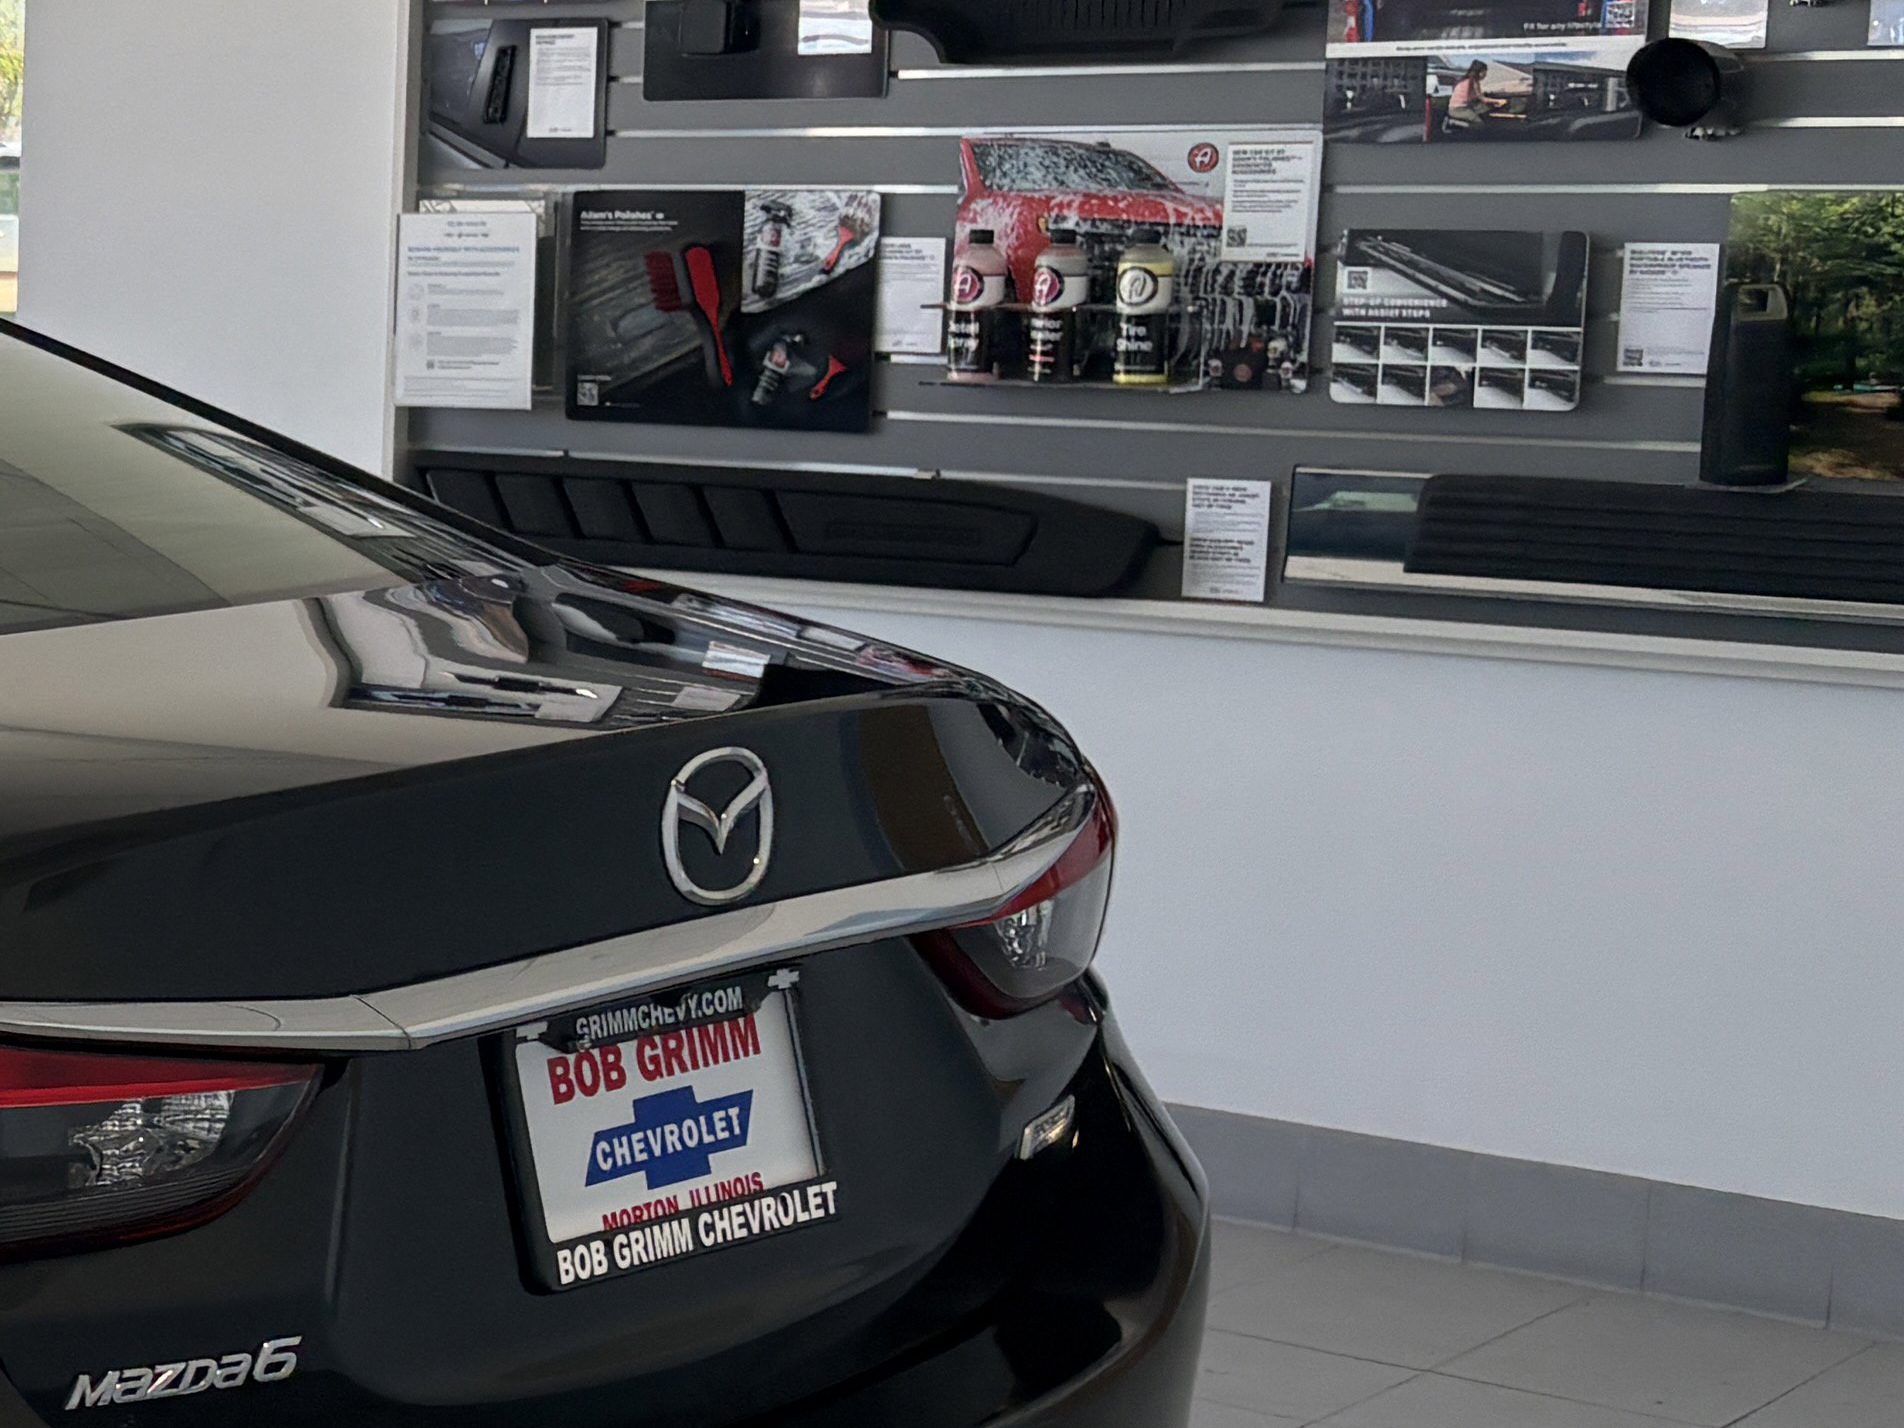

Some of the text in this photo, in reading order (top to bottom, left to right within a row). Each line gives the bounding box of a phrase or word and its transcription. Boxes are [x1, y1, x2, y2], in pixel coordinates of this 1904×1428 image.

[1116, 338, 1153, 352] Shine
[1120, 322, 1147, 337] Tire
[576, 985, 743, 1040] GRIMMCHEVY.COM
[548, 1013, 762, 1105] BOB GRIMM
[595, 1106, 743, 1172] CHEVROLET
[688, 1171, 765, 1209] ILLINOIS
[557, 1180, 838, 1285] BOB GRIMM CHEVROLET
